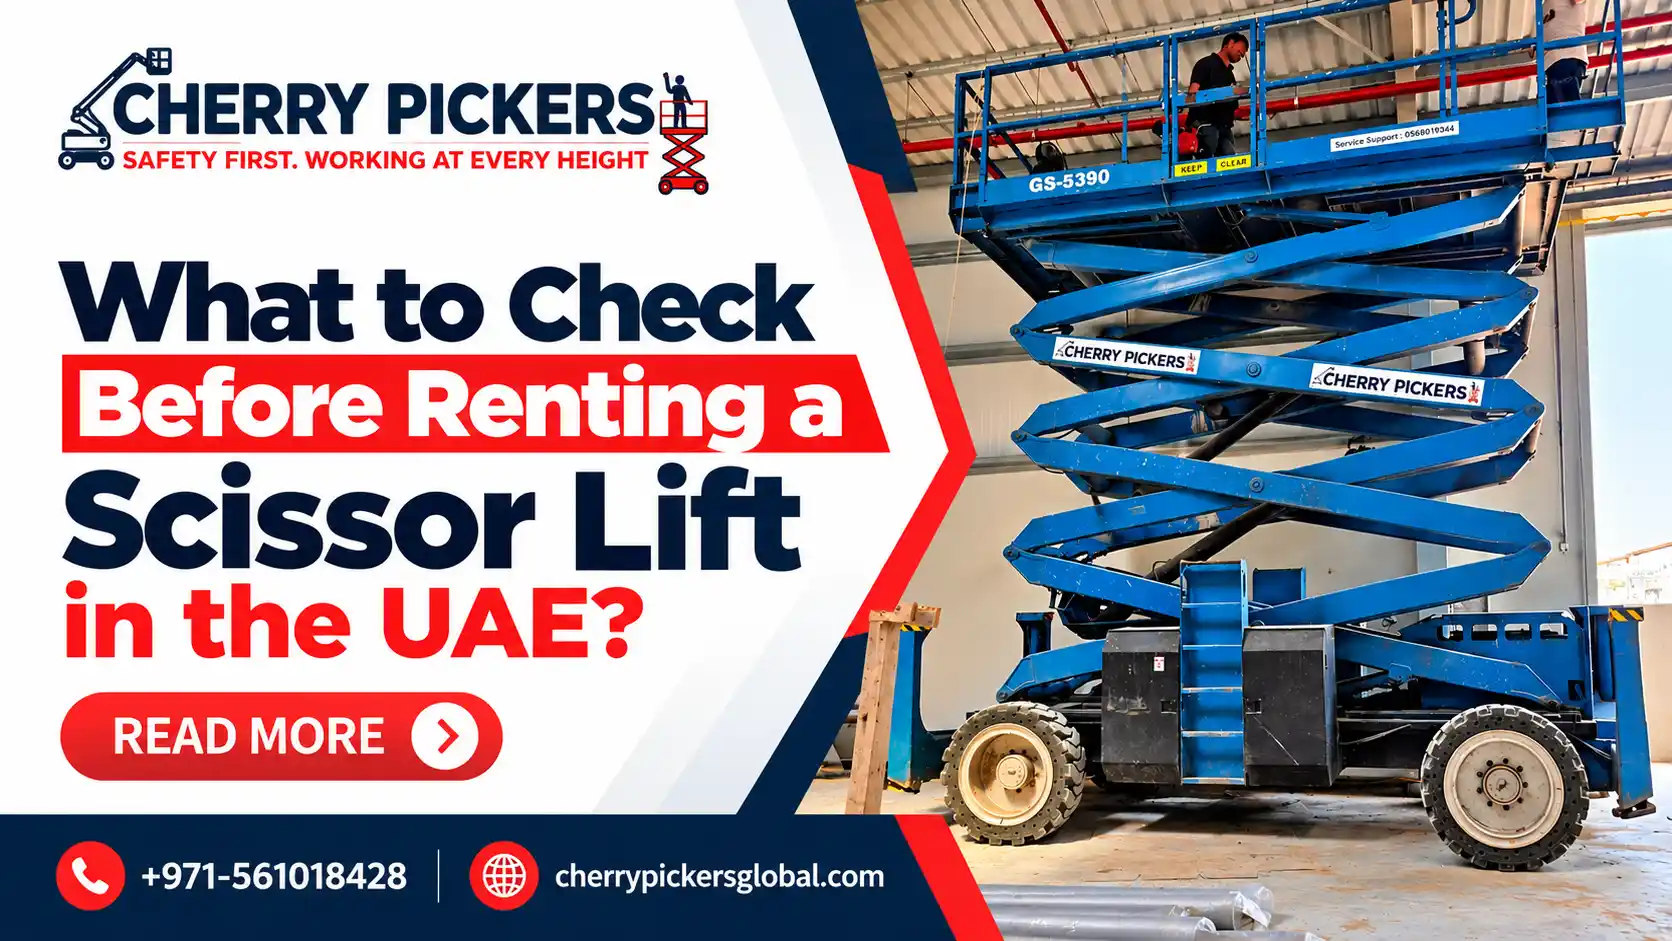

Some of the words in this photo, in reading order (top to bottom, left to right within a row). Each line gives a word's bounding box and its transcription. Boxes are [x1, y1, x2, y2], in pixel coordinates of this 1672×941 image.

[1335, 137, 1365, 149] Service
[1366, 131, 1399, 144] Support
[1181, 164, 1203, 174] KEEP
[1220, 158, 1247, 168] CLEAR
[1029, 168, 1110, 193] GS-5390
[1064, 345, 1121, 362] CHERRY
[1124, 350, 1185, 369] PICKERS
[1323, 372, 1390, 392] CHERRY
[1394, 379, 1467, 400] PICKERS
